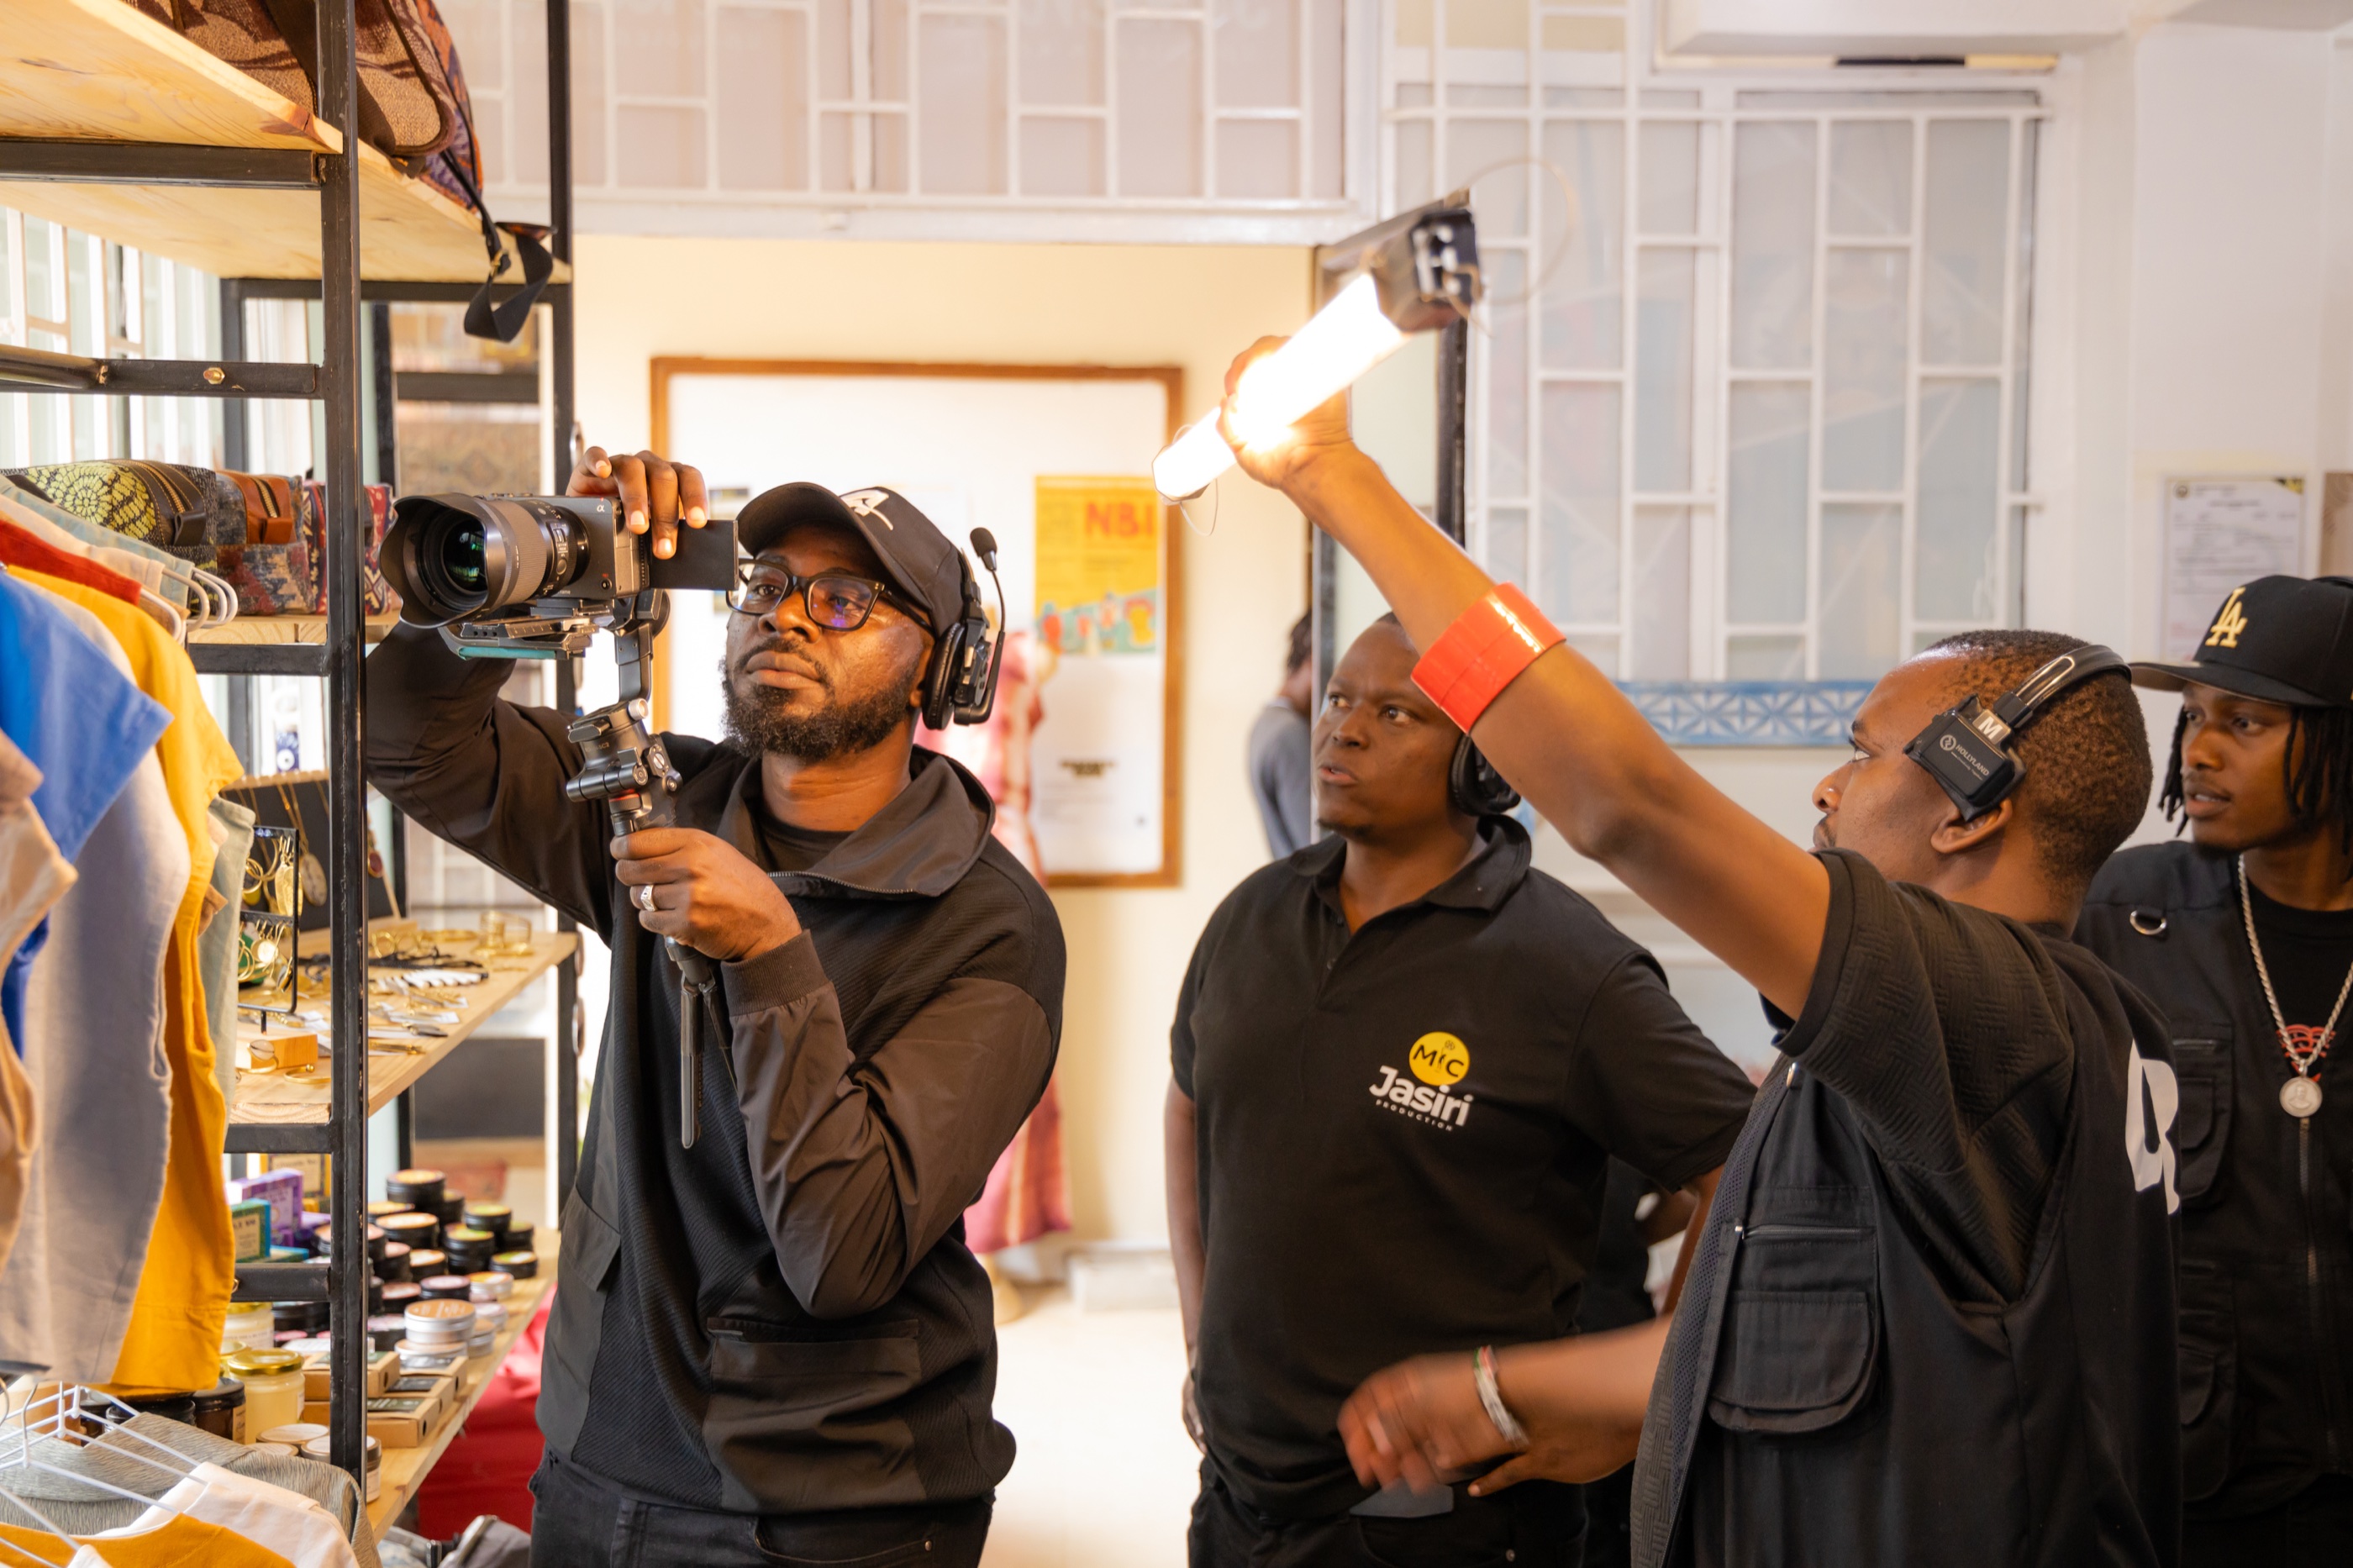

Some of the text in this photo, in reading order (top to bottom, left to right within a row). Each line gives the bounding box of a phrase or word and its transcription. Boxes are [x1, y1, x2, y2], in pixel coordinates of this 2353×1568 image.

[2204, 587, 2248, 649] LA
[1977, 715, 2003, 740] M
[1955, 744, 1990, 776] HOLLYLAND
[1368, 1064, 1475, 1127] Jasiri
[1375, 1098, 1453, 1132] PRODUCTION
